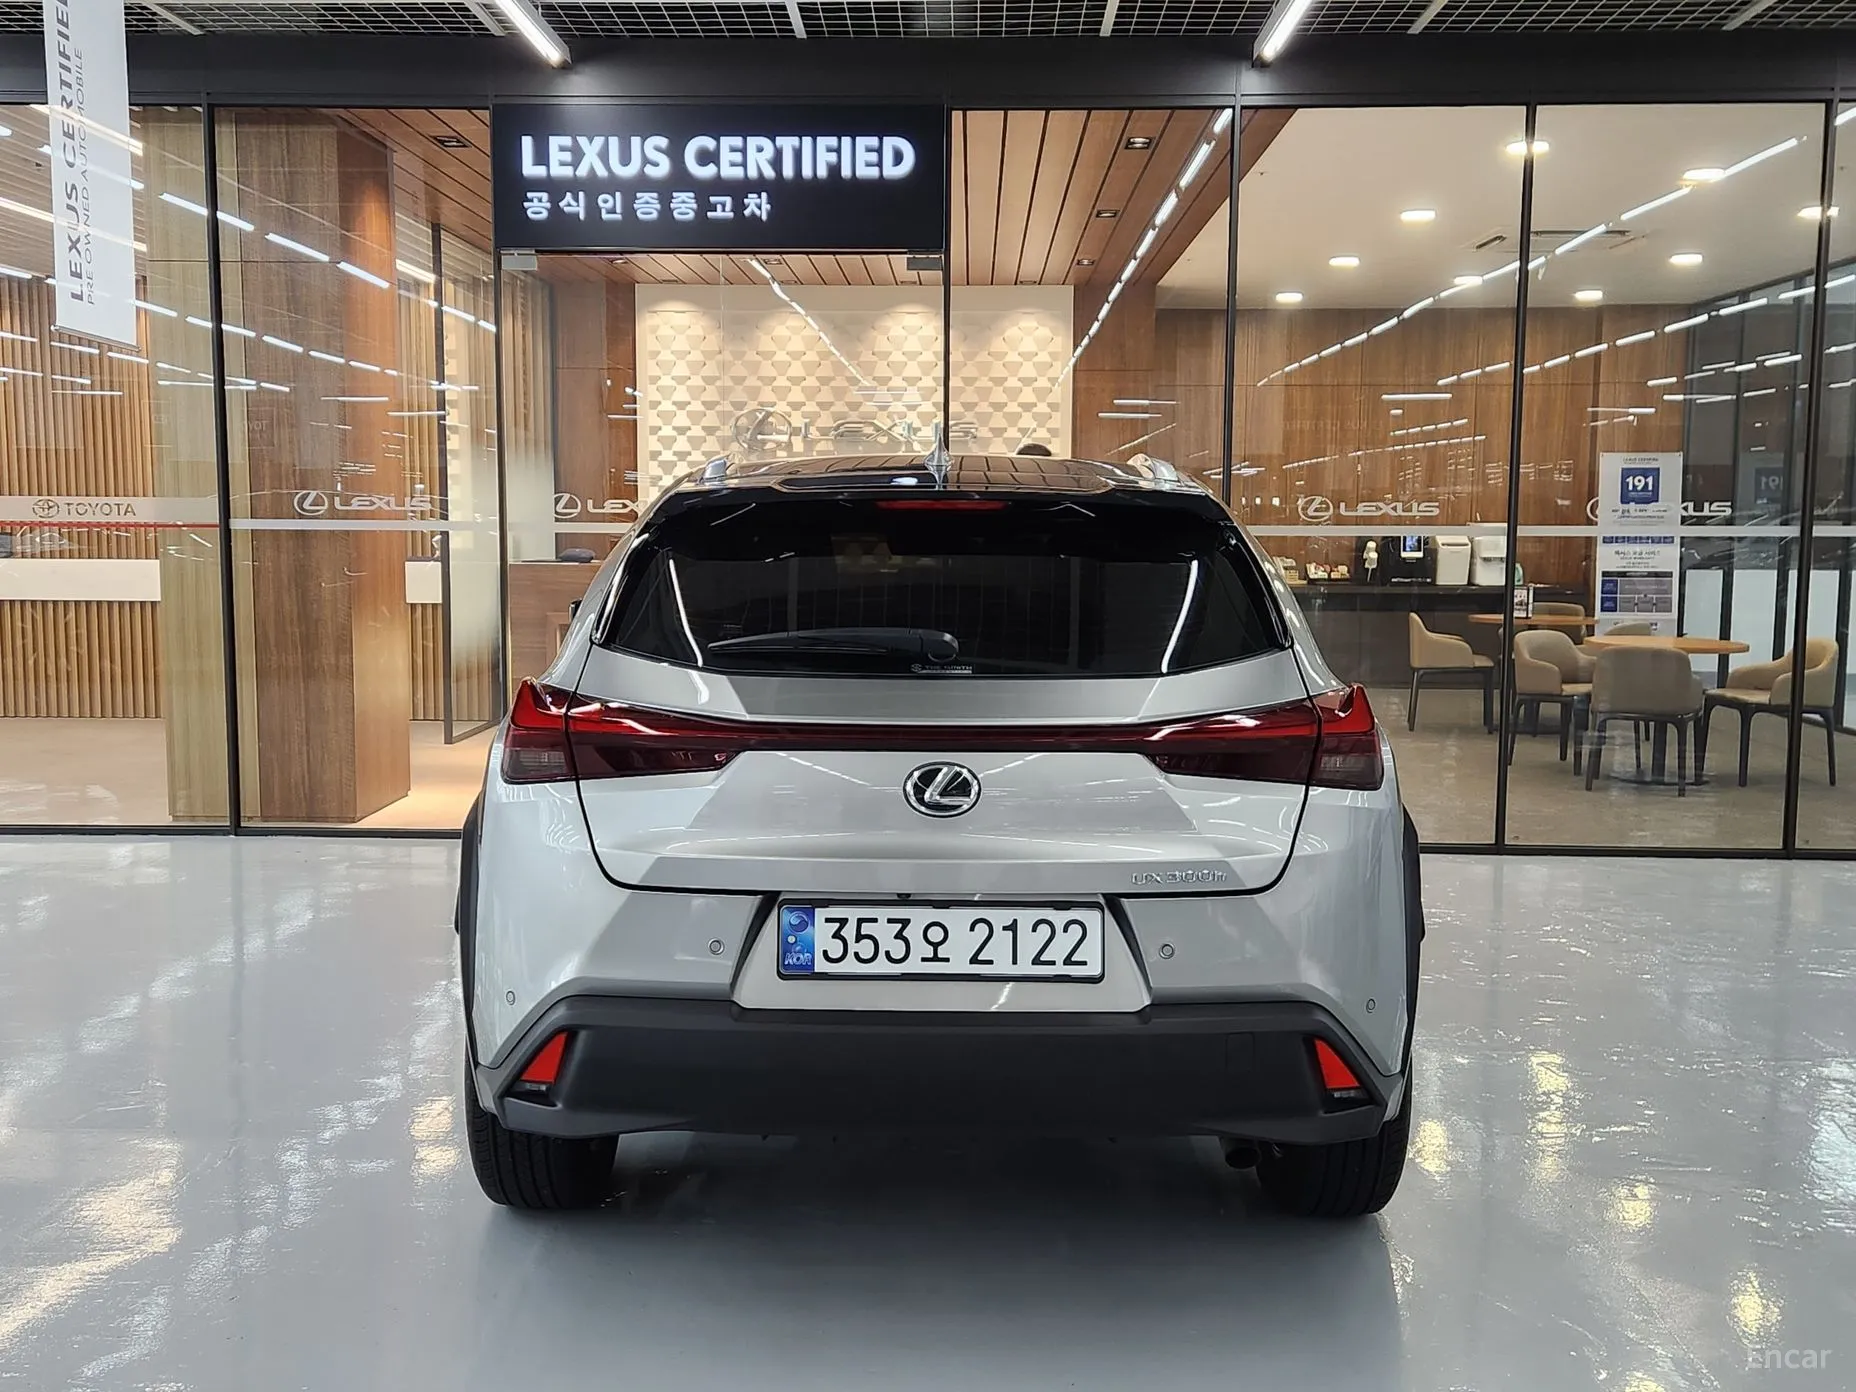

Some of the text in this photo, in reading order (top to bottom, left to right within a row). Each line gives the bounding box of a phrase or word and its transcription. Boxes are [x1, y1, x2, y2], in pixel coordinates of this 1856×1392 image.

[521, 135, 916, 181] LEXUS CERTIFIED
[74, 47, 95, 305] PRE OWNED AUTOMOBILE
[64, 181, 84, 302] LEXUS
[801, 417, 977, 442] LEXUS
[1625, 475, 1654, 491] 191
[64, 502, 136, 516] TOYOTA
[334, 496, 431, 510] LEXUS
[1340, 502, 1440, 516] LEXUS
[822, 917, 1088, 966] 353오 2122
[784, 952, 812, 965] KOR
